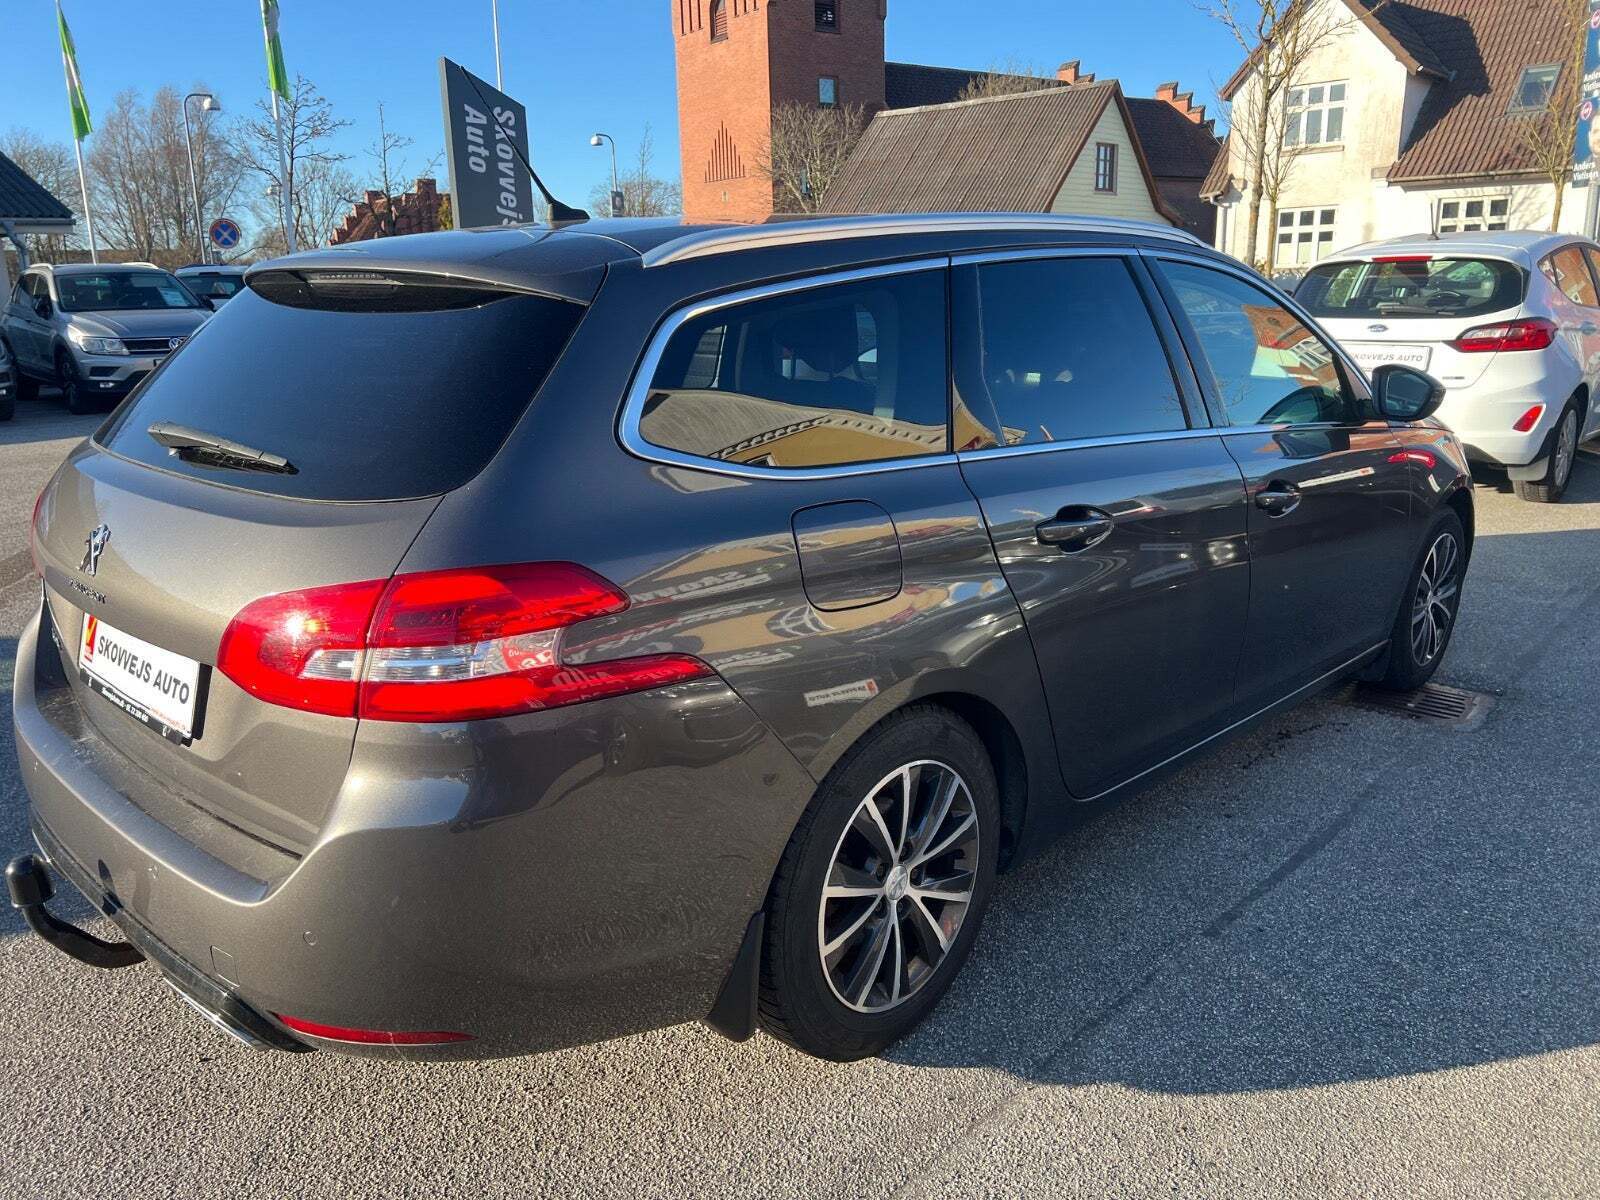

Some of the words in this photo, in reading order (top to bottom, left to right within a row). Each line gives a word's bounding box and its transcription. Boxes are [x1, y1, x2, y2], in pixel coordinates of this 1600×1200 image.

[464, 104, 489, 174] Auto
[1352, 352, 1394, 361] KOVVEJS
[1397, 354, 1423, 362] AUTO
[98, 635, 152, 684] SKOVVEJS
[153, 669, 190, 705] AUTO
